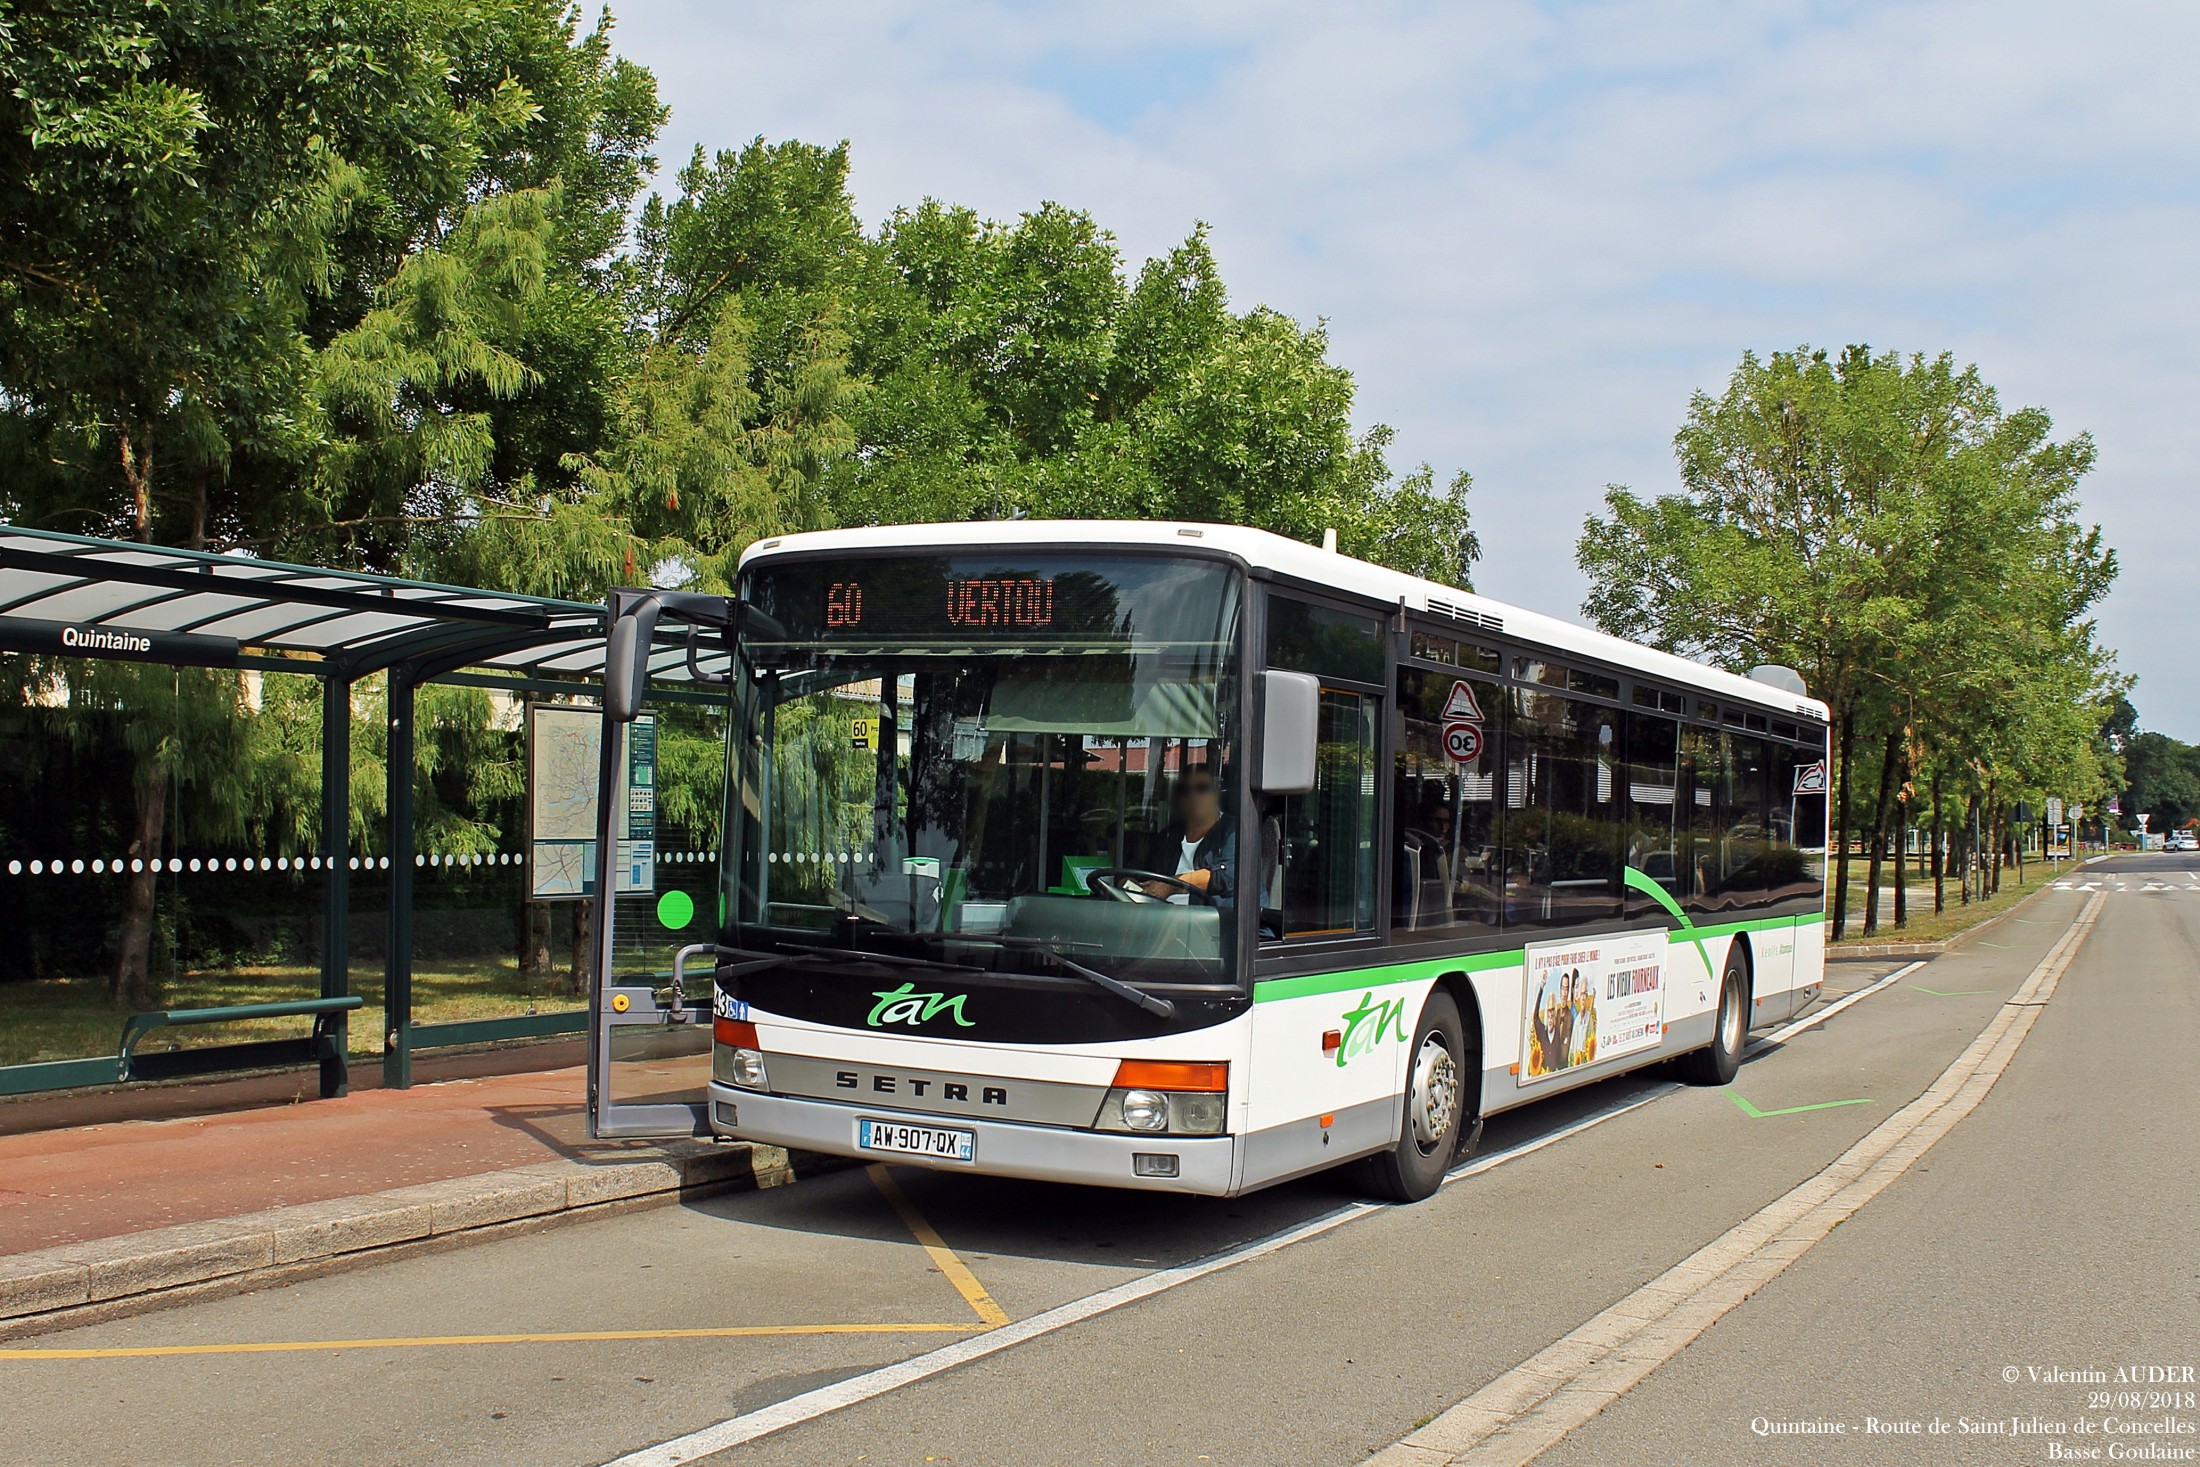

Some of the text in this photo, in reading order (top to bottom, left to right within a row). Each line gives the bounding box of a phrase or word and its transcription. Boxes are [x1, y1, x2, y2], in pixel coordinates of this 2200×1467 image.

[828, 579, 1053, 627] 60 VERTOU
[62, 627, 151, 652] Quintaine
[853, 721, 867, 737] 60
[867, 982, 976, 1027] tan
[1336, 991, 1409, 1068] tan
[836, 1071, 1007, 1105] SETRA
[960, 1147, 971, 1158] 44
